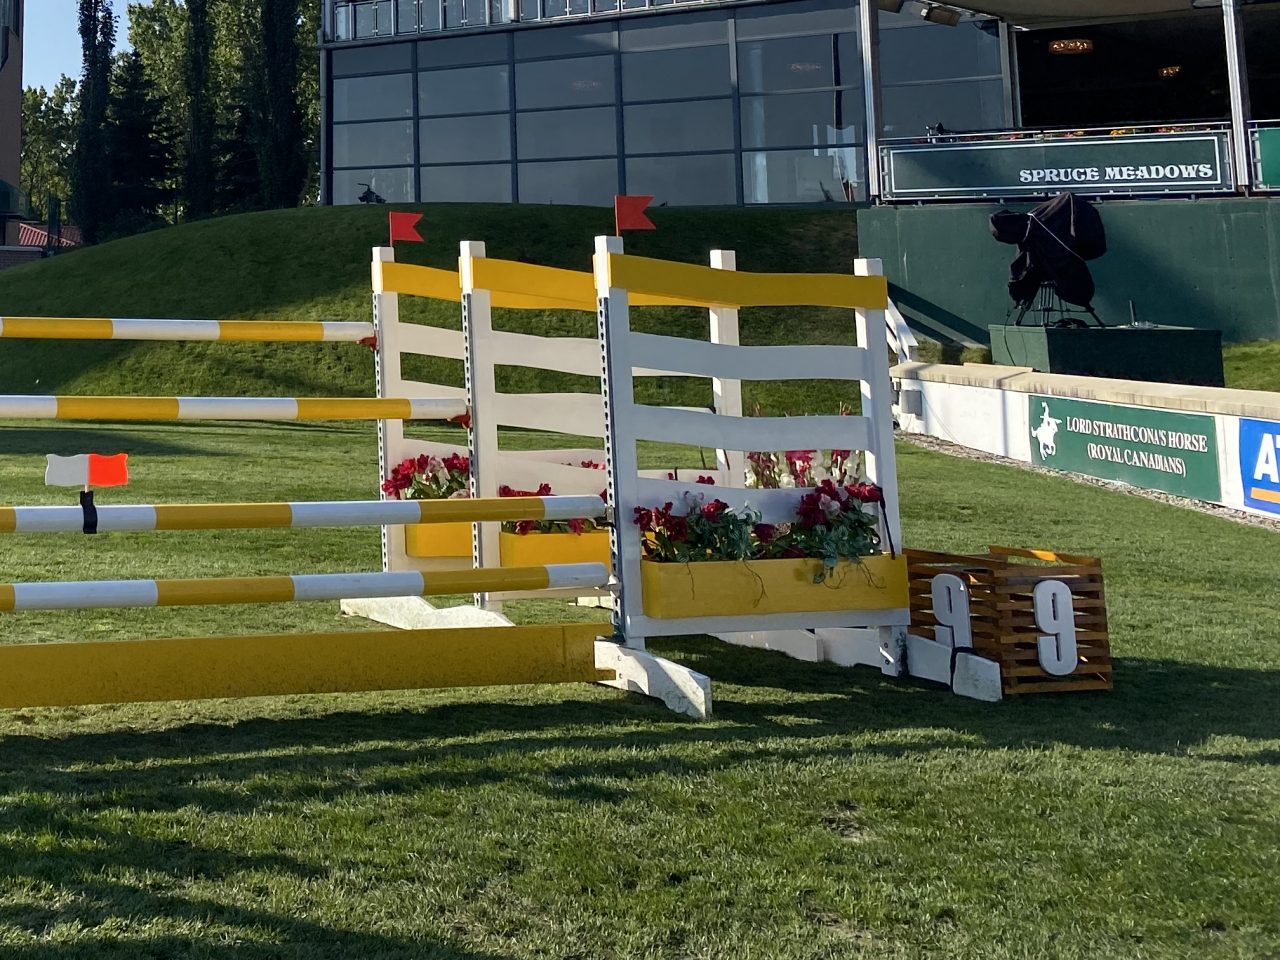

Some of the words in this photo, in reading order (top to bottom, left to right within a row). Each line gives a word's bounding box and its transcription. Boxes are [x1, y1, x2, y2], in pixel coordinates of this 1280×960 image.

[1019, 168, 1100, 183] SPRUCE
[1104, 163, 1214, 181] MEADOWS
[1066, 416, 1093, 435] LORD
[1093, 420, 1168, 447] STRATHCONA'S
[1168, 431, 1208, 453] HORSE
[1087, 442, 1124, 464] (ROYAL
[1124, 449, 1187, 478] CANADIANS)
[1032, 579, 1079, 676] 9
